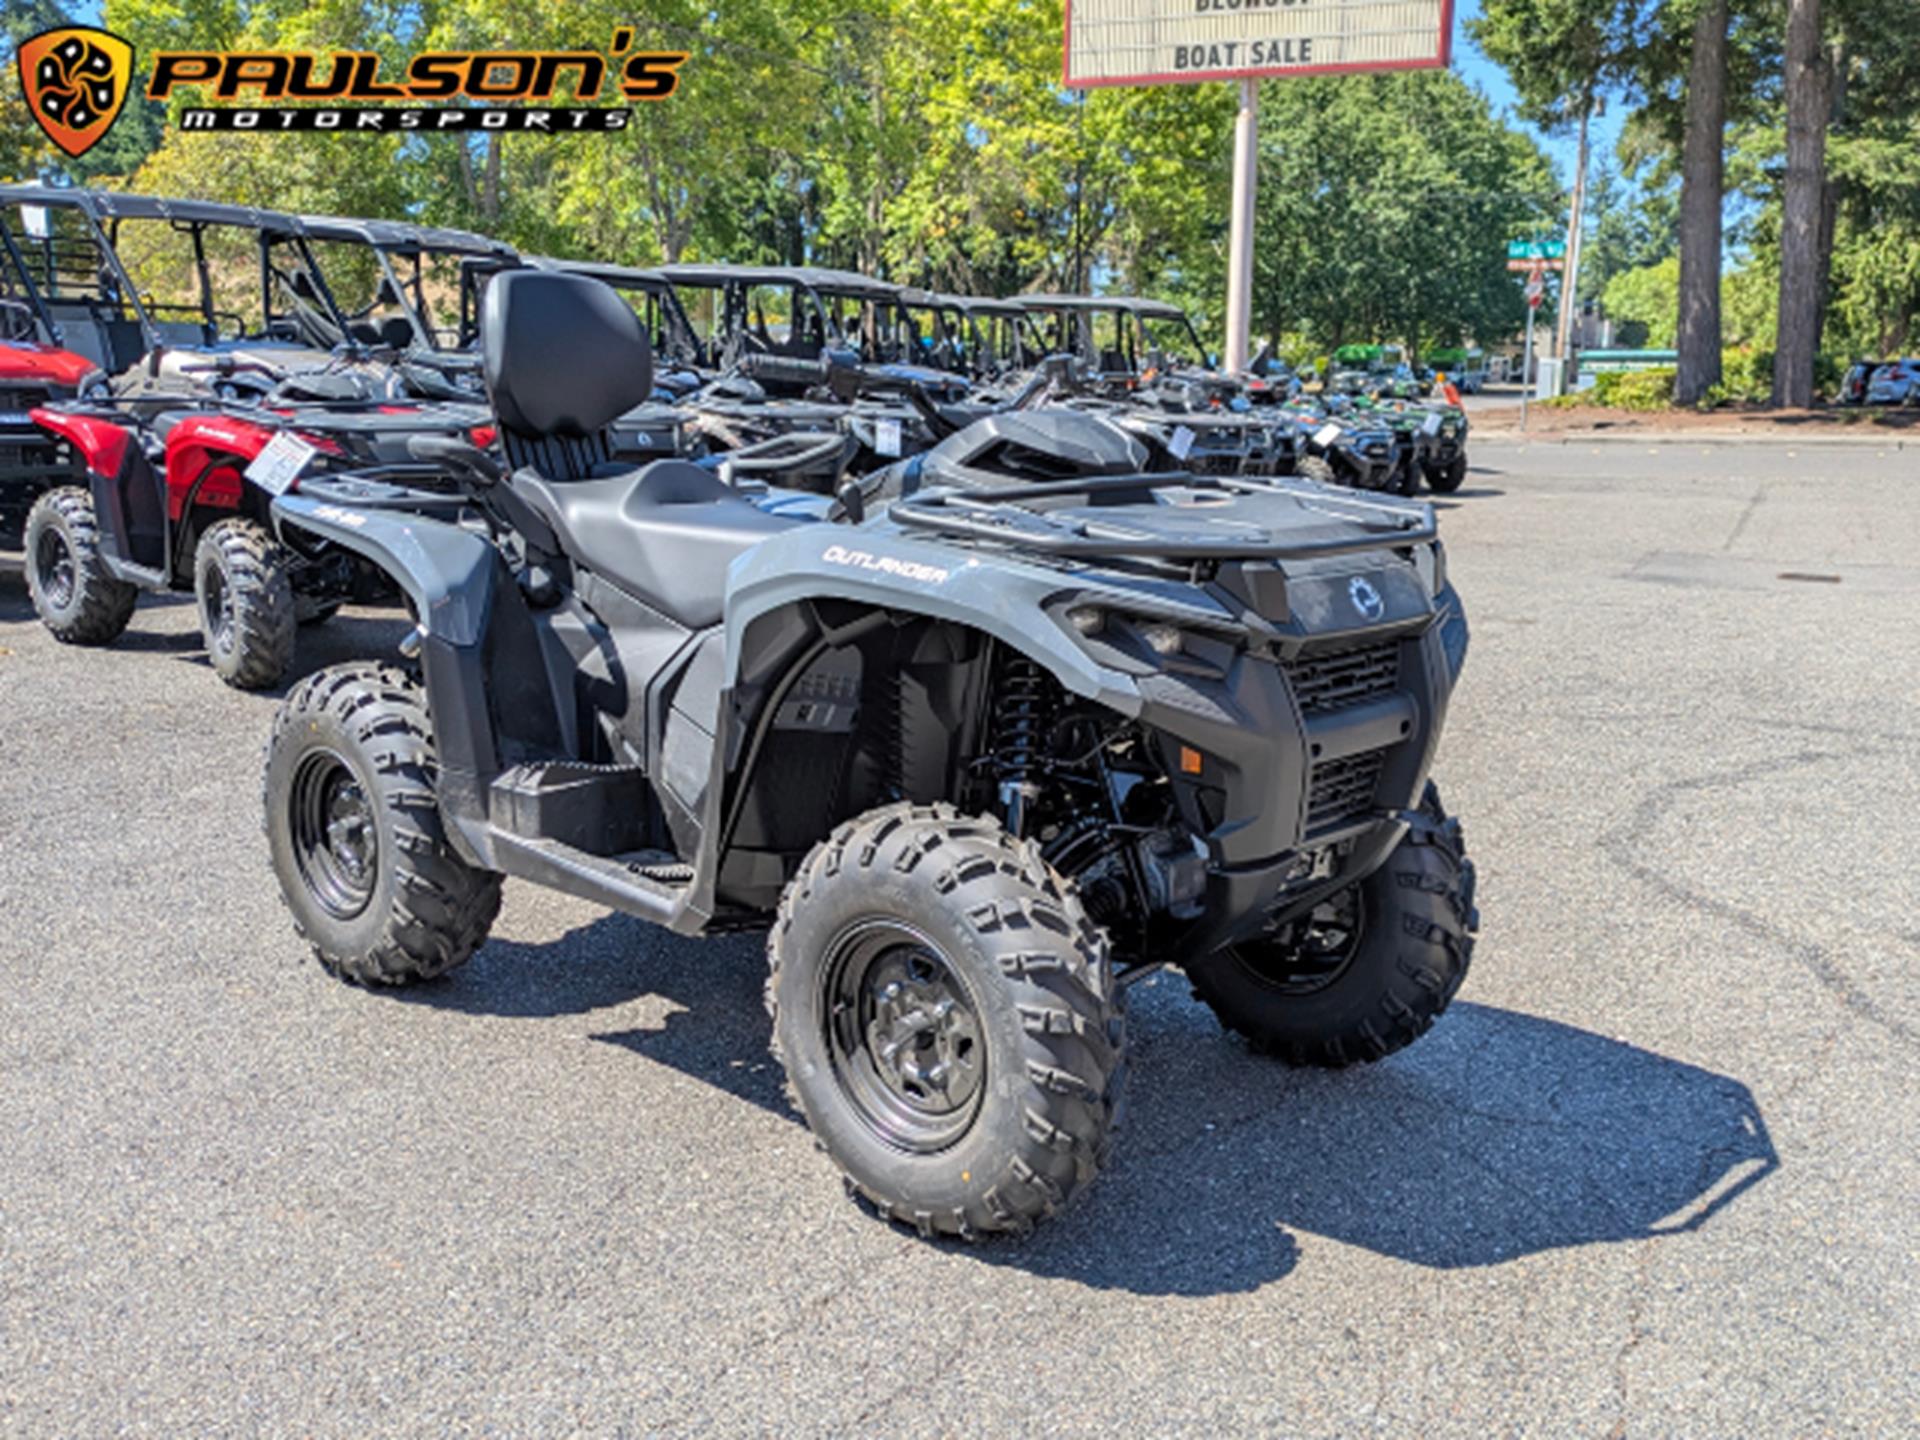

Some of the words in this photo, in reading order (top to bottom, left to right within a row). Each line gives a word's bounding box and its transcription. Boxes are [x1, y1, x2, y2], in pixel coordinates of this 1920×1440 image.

[1174, 42, 1237, 69] BOAT
[1250, 38, 1312, 64] SALE
[822, 545, 949, 584] OUTLANDER
